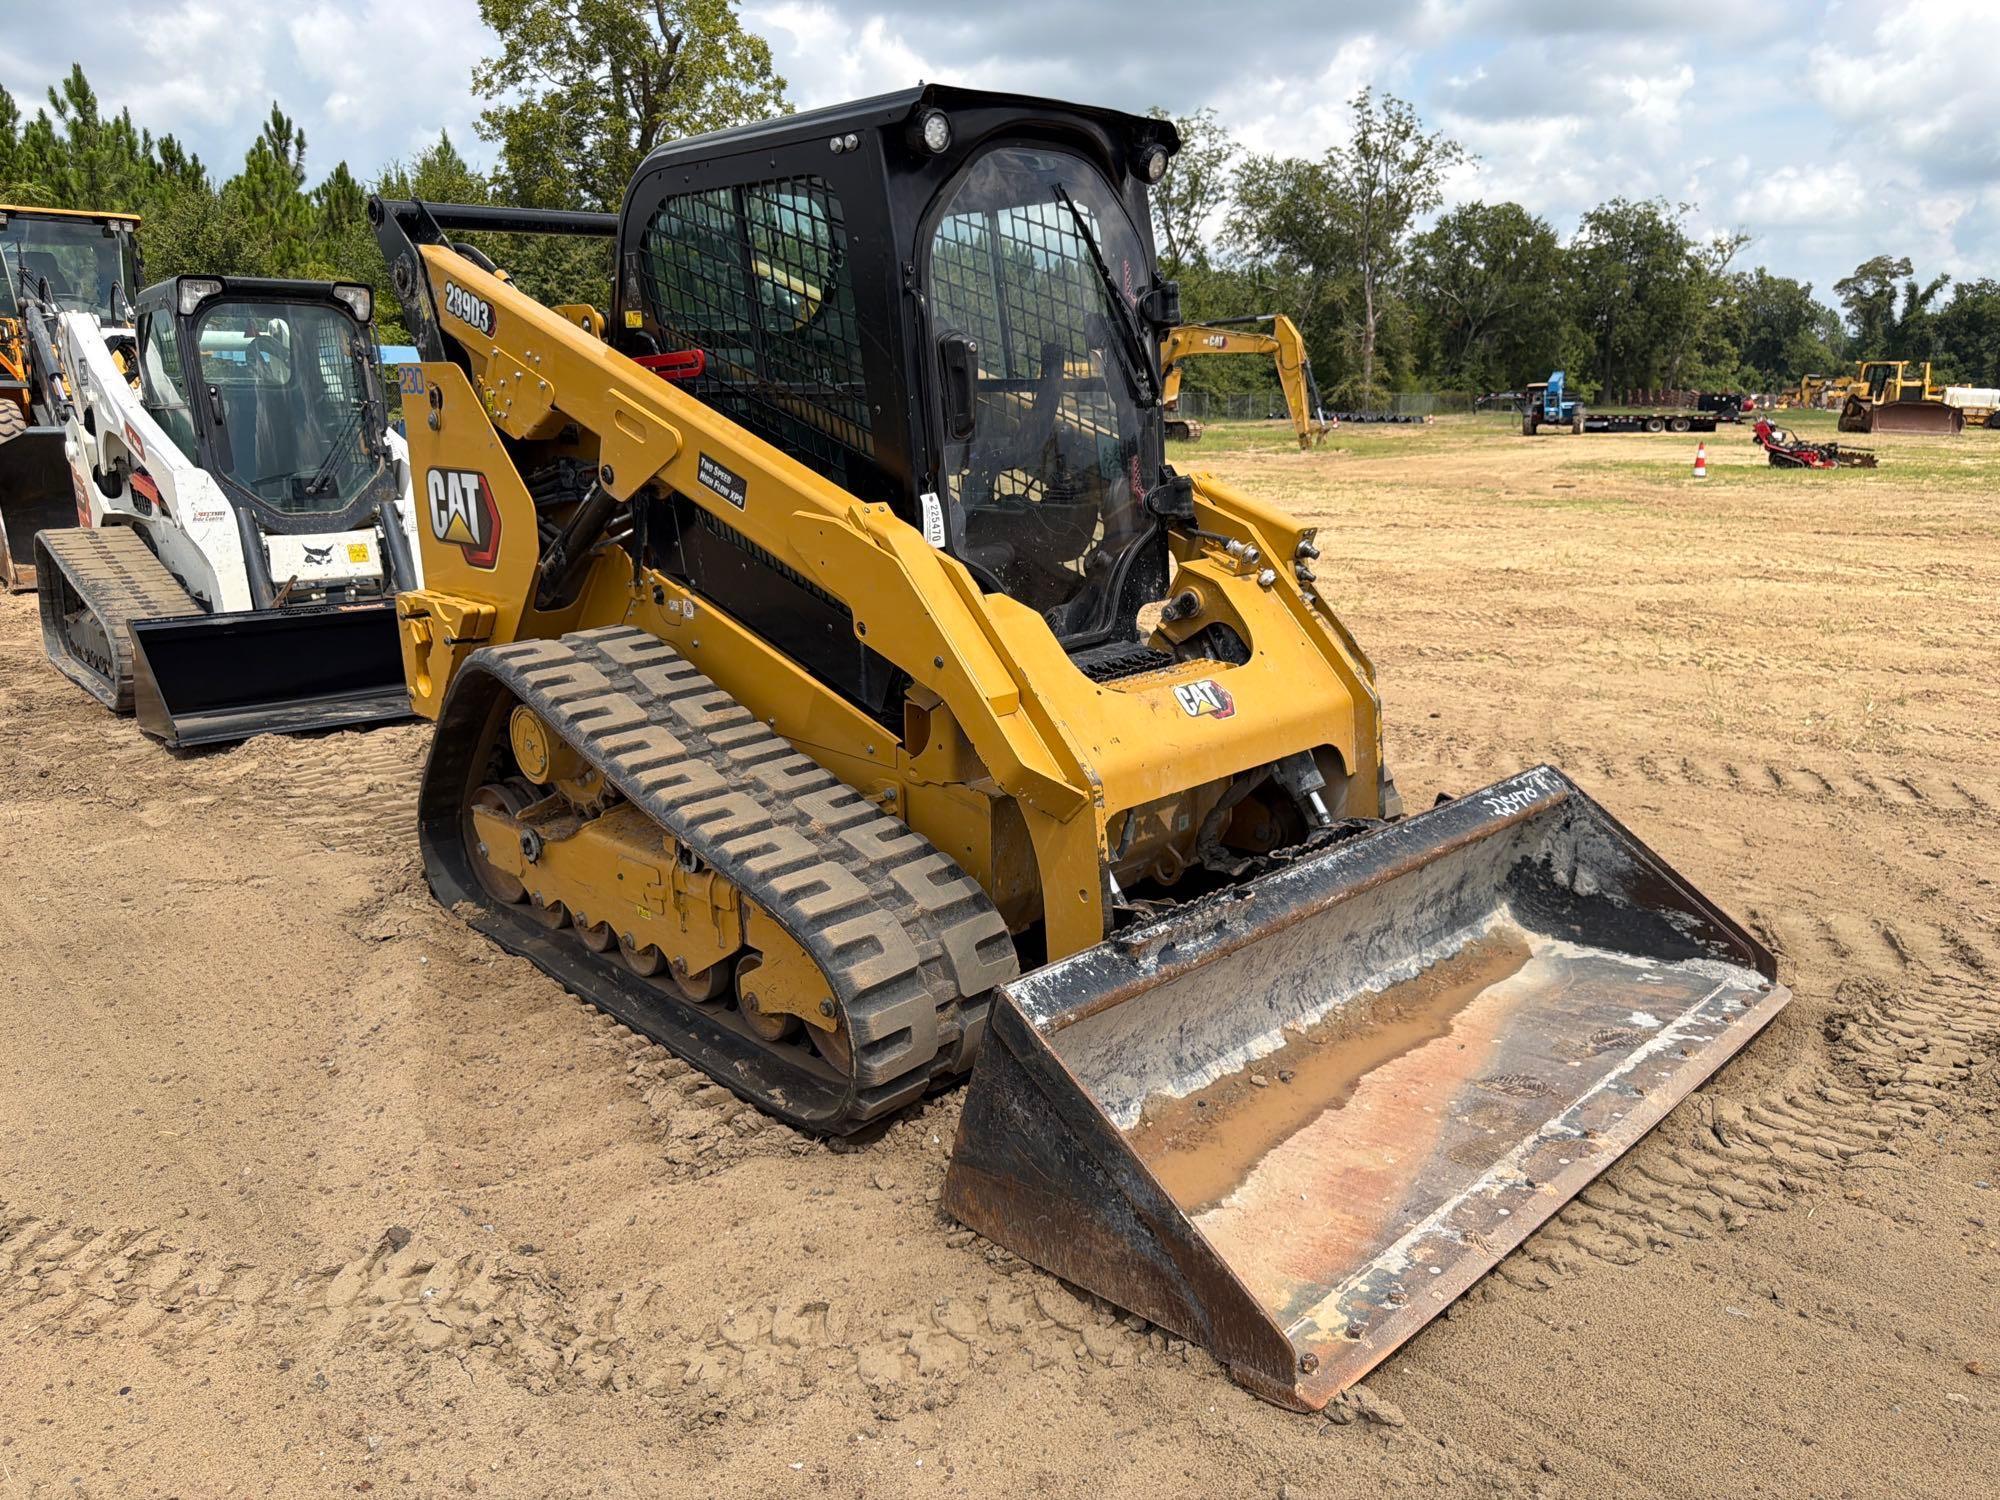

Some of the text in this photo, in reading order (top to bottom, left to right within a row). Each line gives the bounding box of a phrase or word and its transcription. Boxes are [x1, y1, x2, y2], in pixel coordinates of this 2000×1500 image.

[446, 282, 489, 333] 289D3
[1209, 335, 1224, 347] CAT
[427, 469, 480, 545] CAT
[714, 480, 730, 496] FLOW
[730, 490, 744, 506] XPS
[930, 504, 942, 542] 225470
[1174, 681, 1222, 716] CAT
[1482, 786, 1538, 817] 225470
